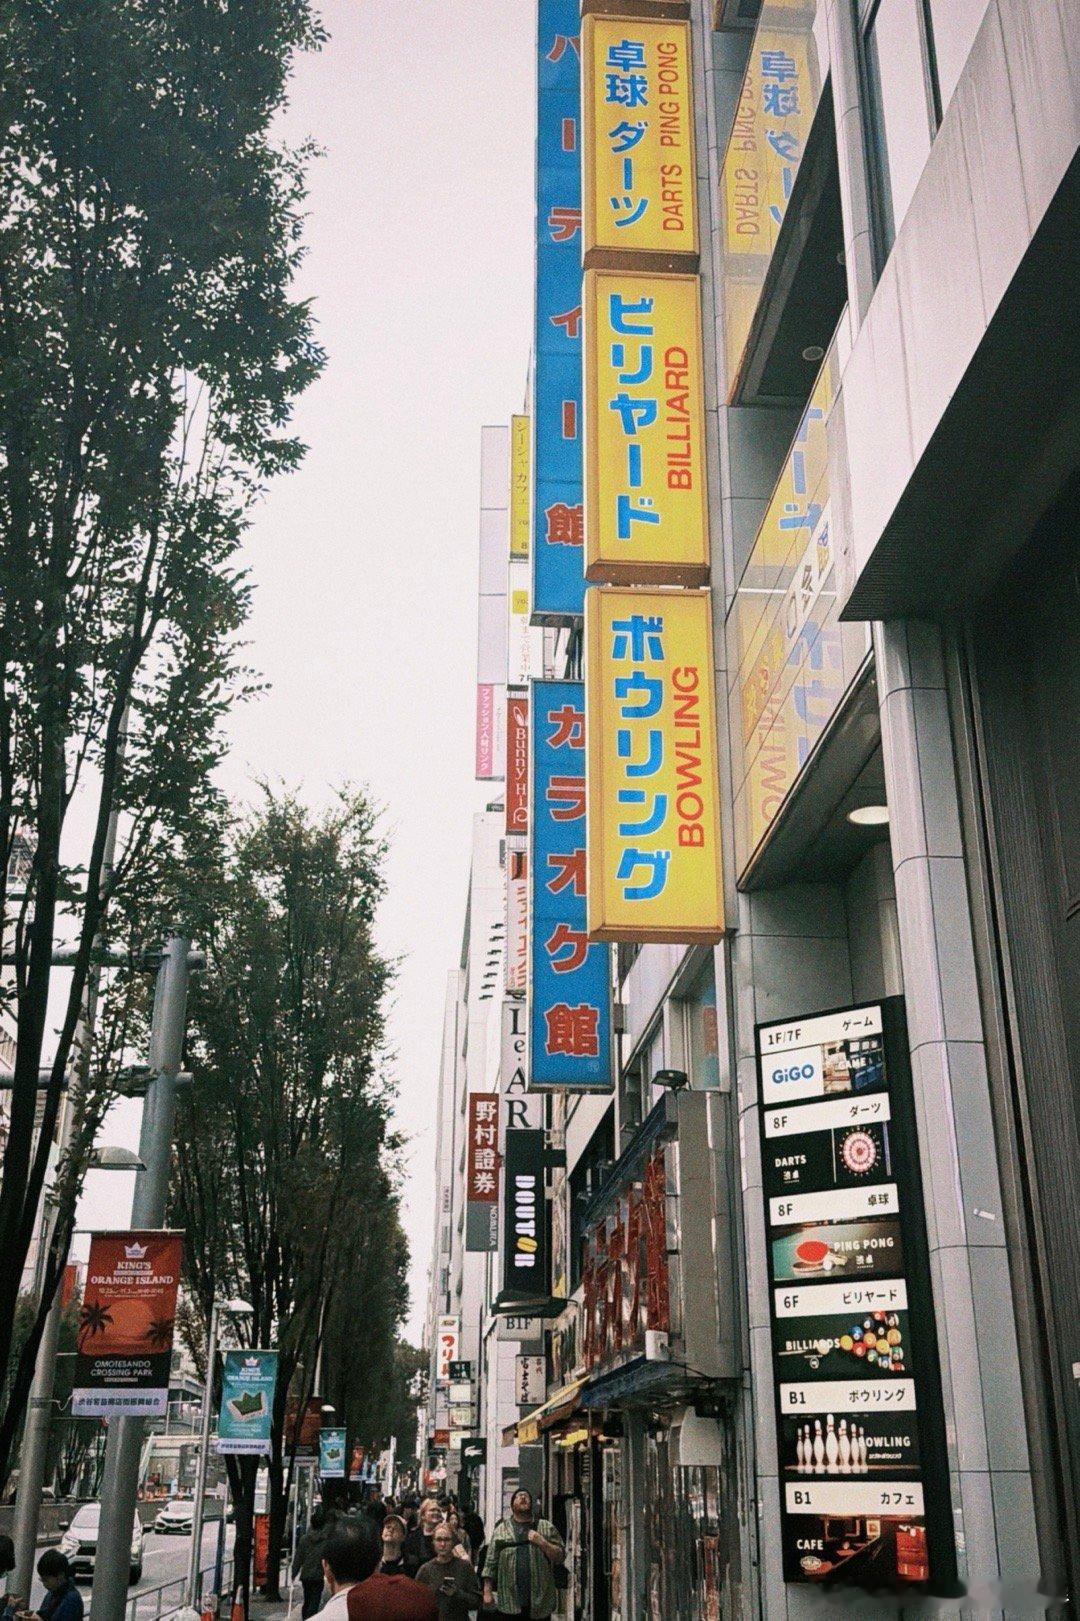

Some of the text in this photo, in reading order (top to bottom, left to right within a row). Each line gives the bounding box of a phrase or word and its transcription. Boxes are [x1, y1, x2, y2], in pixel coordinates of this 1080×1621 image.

[657, 42, 685, 232] DARTS PING PONG
[609, 294, 660, 540] ビリヤード
[664, 346, 692, 490] BILLIARD
[610, 614, 671, 901] ボウリング
[672, 666, 705, 848] BOWLING
[544, 705, 600, 1057] カラオケ館
[767, 1029, 802, 1045] 1F/7F
[772, 1064, 815, 1084] GiGO
[773, 1102, 882, 1130] 8F ダーツ
[474, 1101, 497, 1194] 野村證券
[774, 1154, 807, 1168] DARTS
[778, 1192, 890, 1217] 8F 卓球
[514, 1175, 538, 1267] DOUTOR
[833, 1237, 894, 1254] PING PONG
[91, 1275, 174, 1285] ORANGE ISLAND
[783, 1288, 898, 1308] 6F ビリヤード
[90, 1368, 153, 1377] CROSSING PARK
[789, 1388, 905, 1405] B1 ボウリング
[794, 1491, 915, 1506] B1 カフェ
[797, 1539, 824, 1550] CAFE
